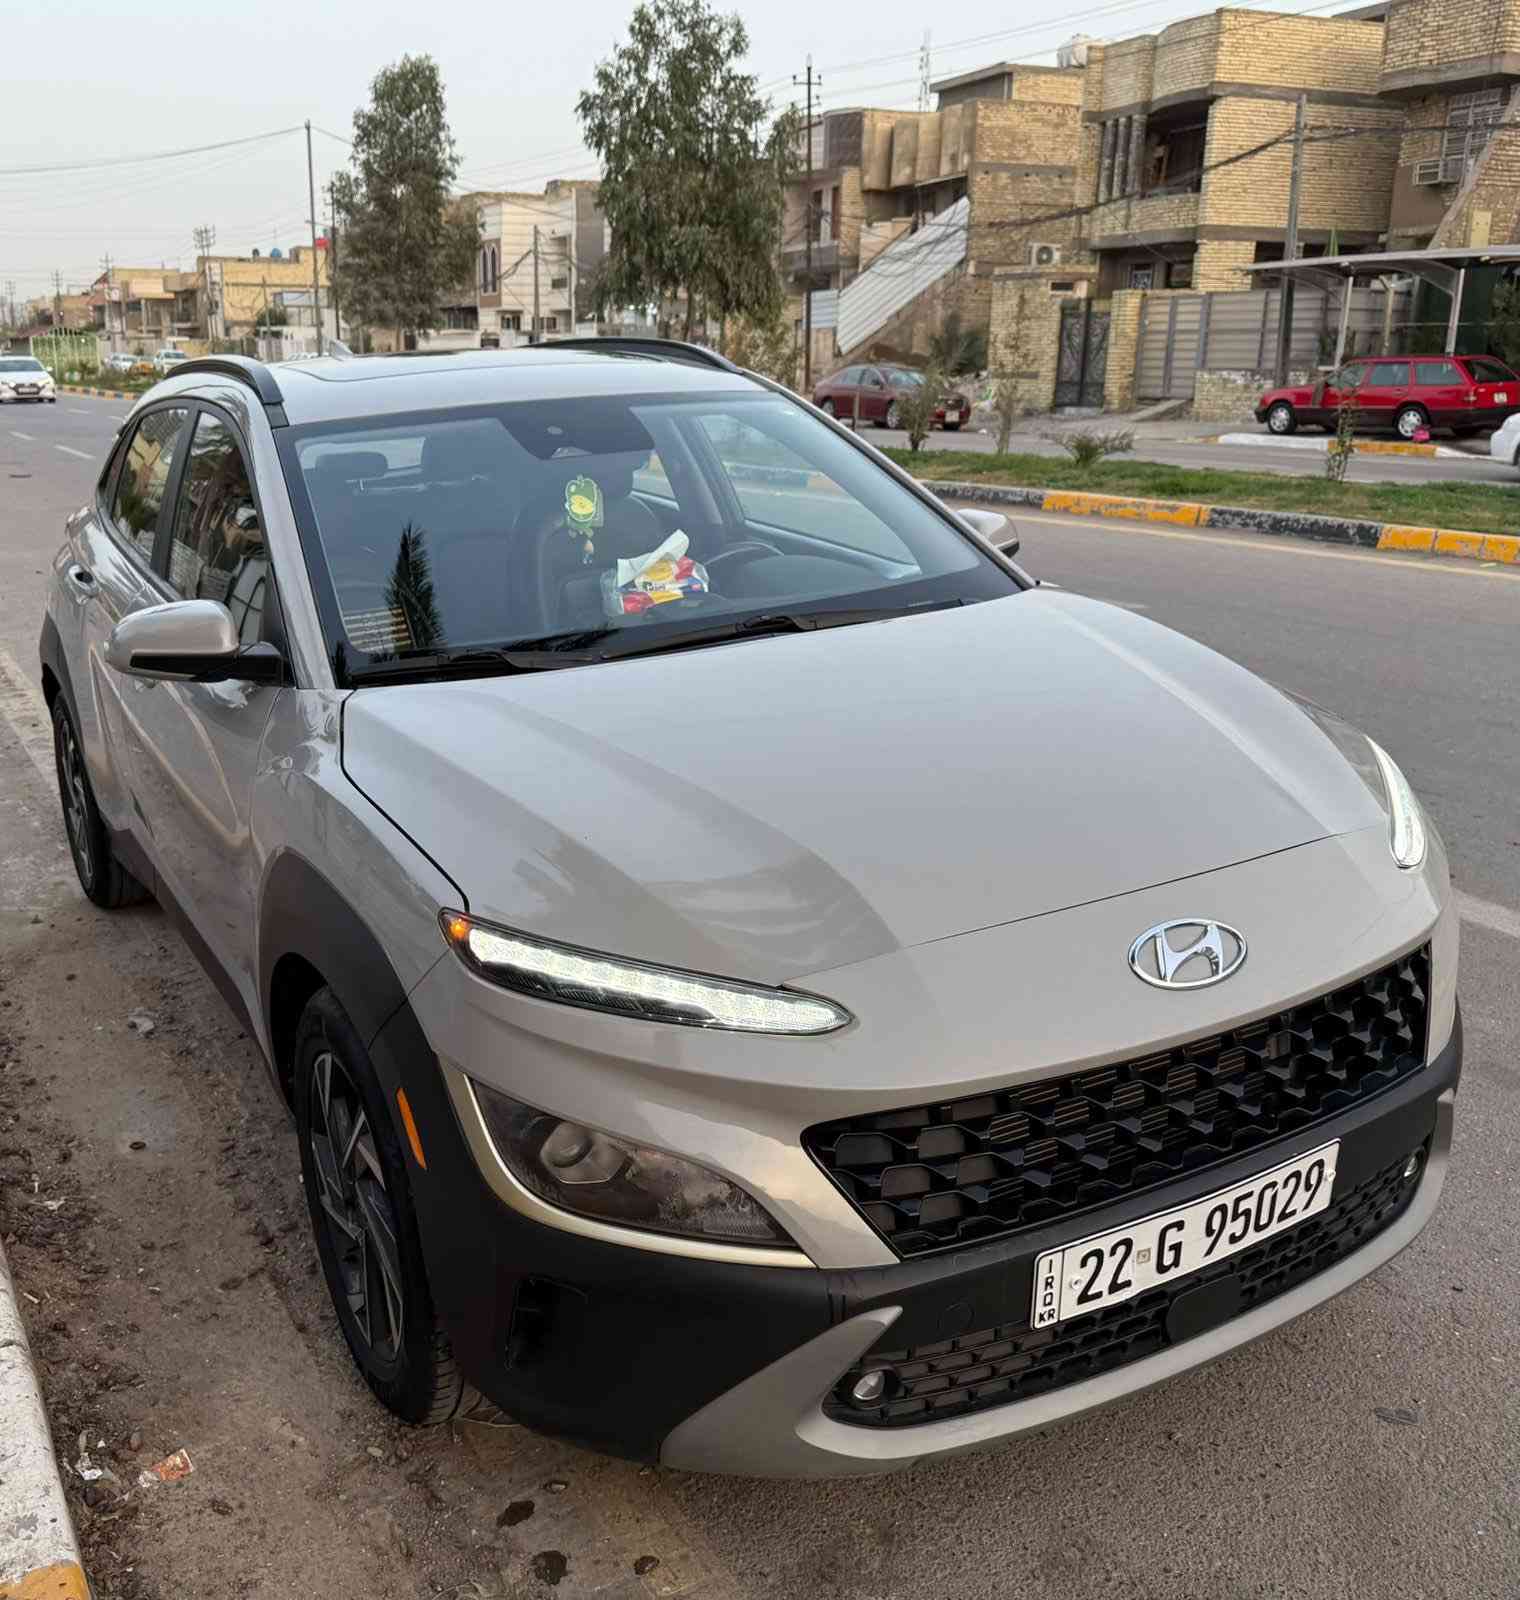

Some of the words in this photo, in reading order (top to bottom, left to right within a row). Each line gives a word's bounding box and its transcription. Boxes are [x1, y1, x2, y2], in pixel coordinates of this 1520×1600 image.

[1077, 1237, 1134, 1306] 22
[1156, 1219, 1185, 1275] G
[1203, 1158, 1325, 1258] 95029
[1038, 1308, 1056, 1323] KR
